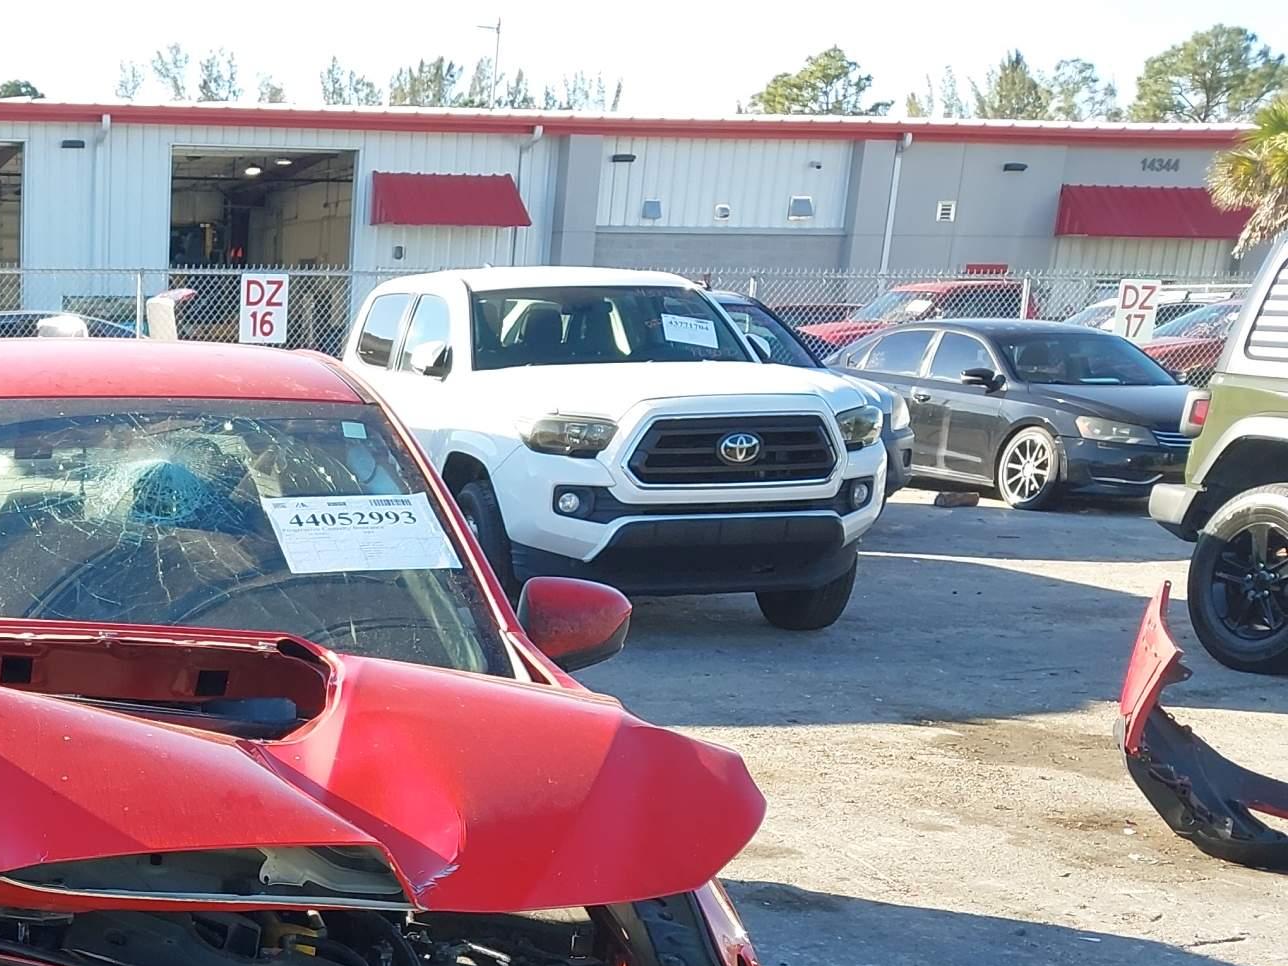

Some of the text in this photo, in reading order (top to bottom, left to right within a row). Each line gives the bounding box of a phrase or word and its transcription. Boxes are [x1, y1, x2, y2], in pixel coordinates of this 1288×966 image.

[1140, 158, 1180, 172] 14344
[246, 280, 283, 306] DZ
[1122, 285, 1157, 310] DZ
[250, 311, 274, 337] 16
[1125, 314, 1145, 337] 17
[289, 510, 417, 527] 44052993
